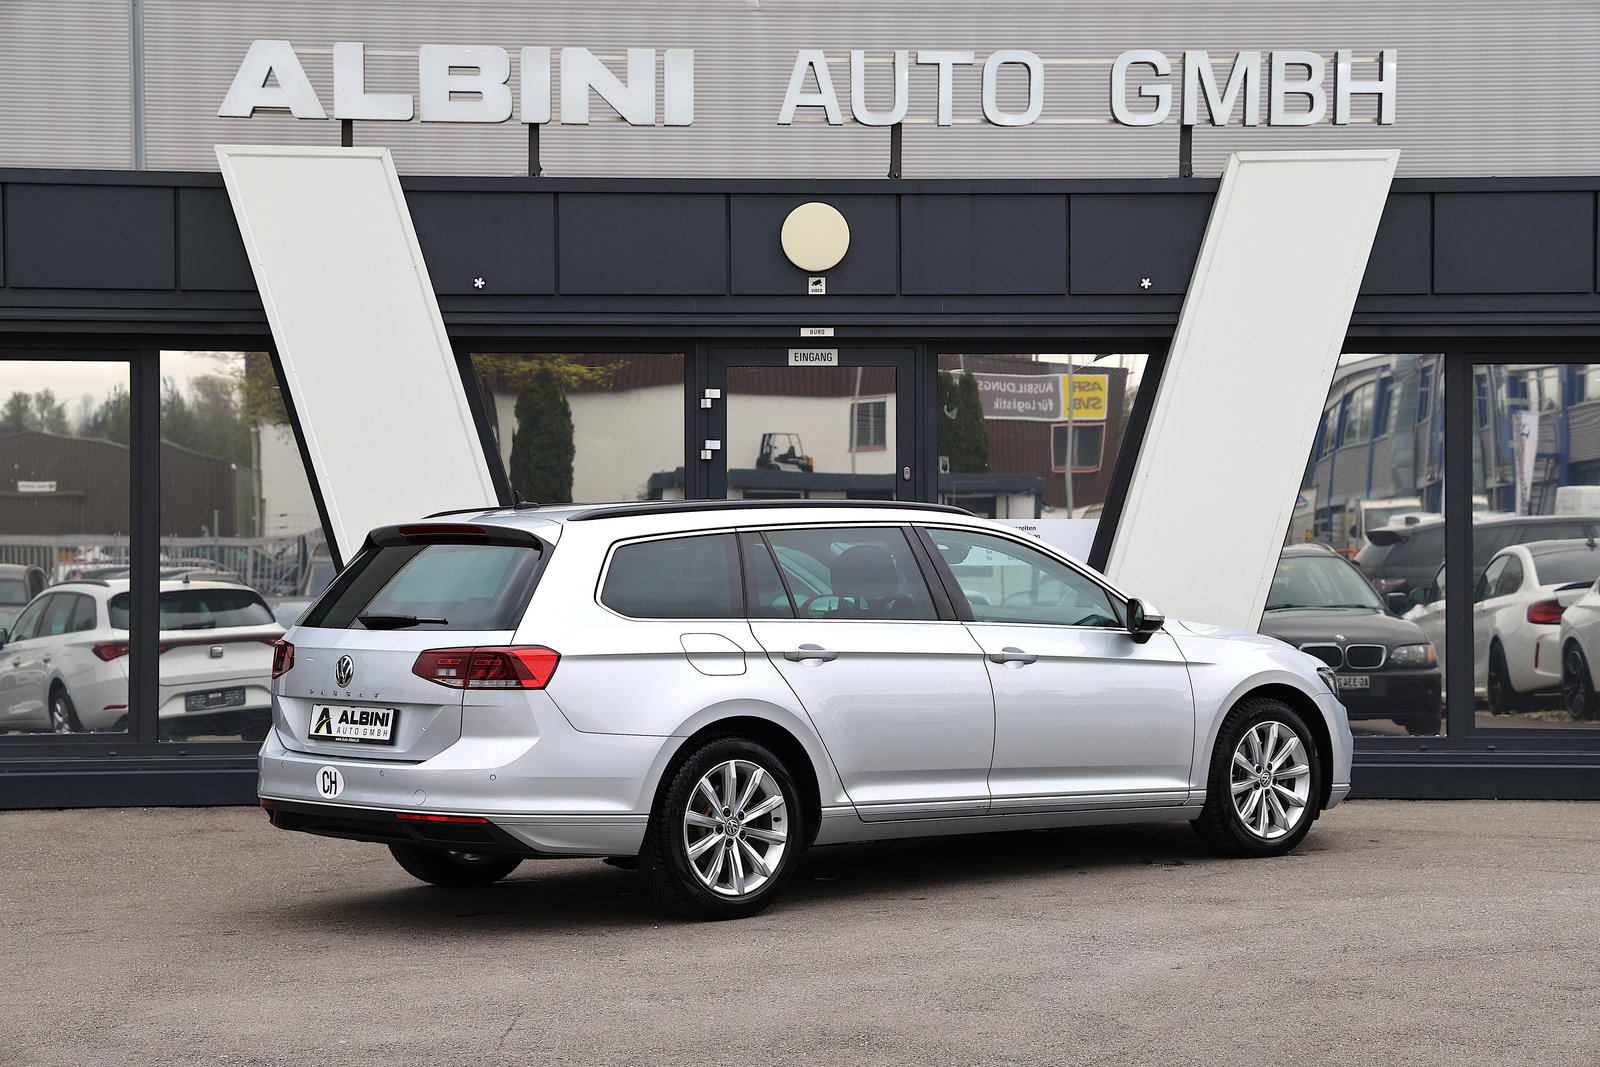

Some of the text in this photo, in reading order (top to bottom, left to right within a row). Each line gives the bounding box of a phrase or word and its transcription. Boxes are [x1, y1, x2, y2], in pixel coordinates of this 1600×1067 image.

[218, 40, 1398, 127] ALBINI AUTO GMBH
[794, 352, 833, 362] EINGANG
[338, 710, 390, 727] ALBINI
[336, 726, 388, 737] AUTO GMBH
[322, 770, 338, 795] CH
